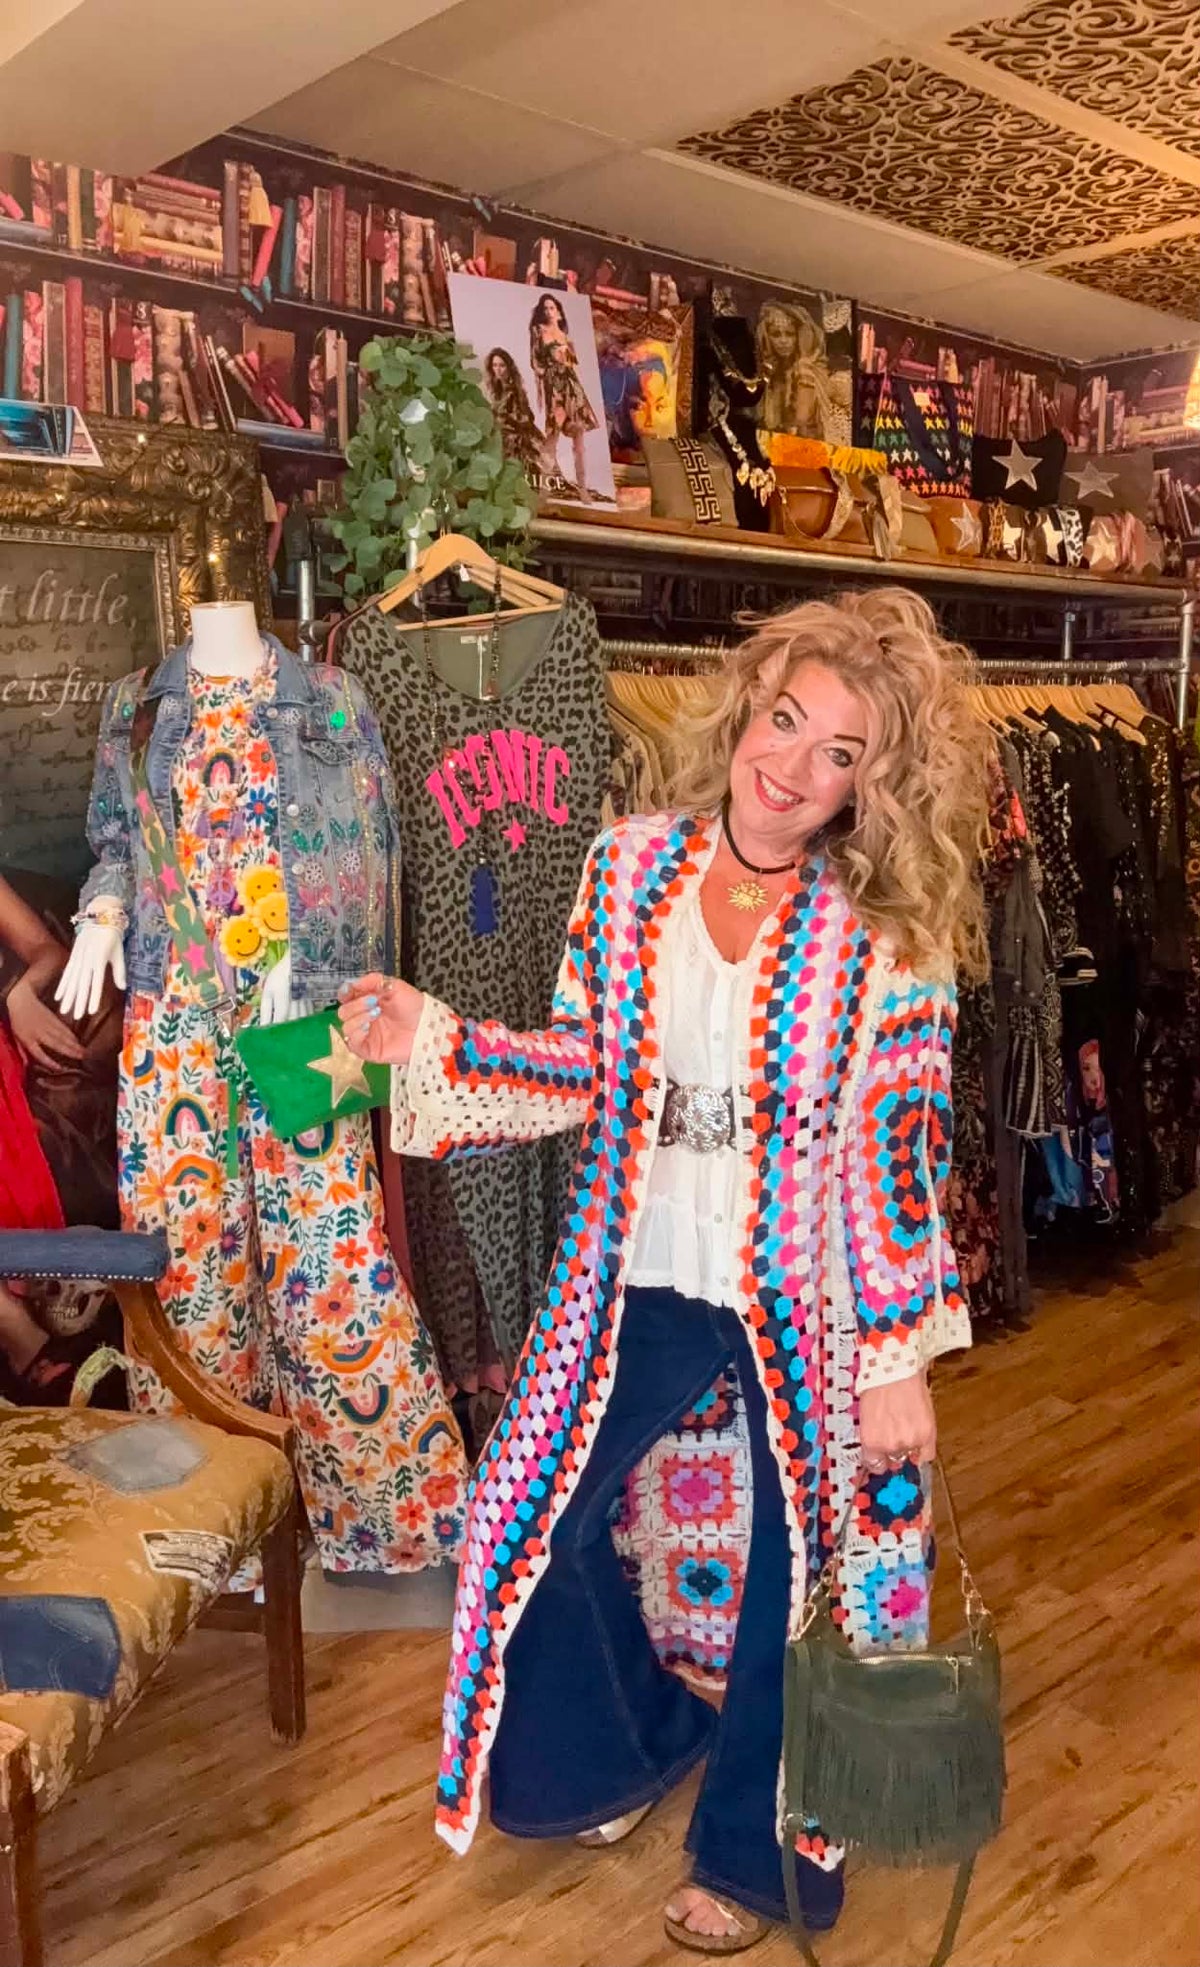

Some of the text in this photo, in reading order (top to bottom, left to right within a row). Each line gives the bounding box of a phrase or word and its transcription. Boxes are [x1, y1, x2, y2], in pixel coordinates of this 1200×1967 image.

[27, 570, 136, 630] little,
[28, 673, 50, 701] is
[425, 729, 570, 849] ICONIC
